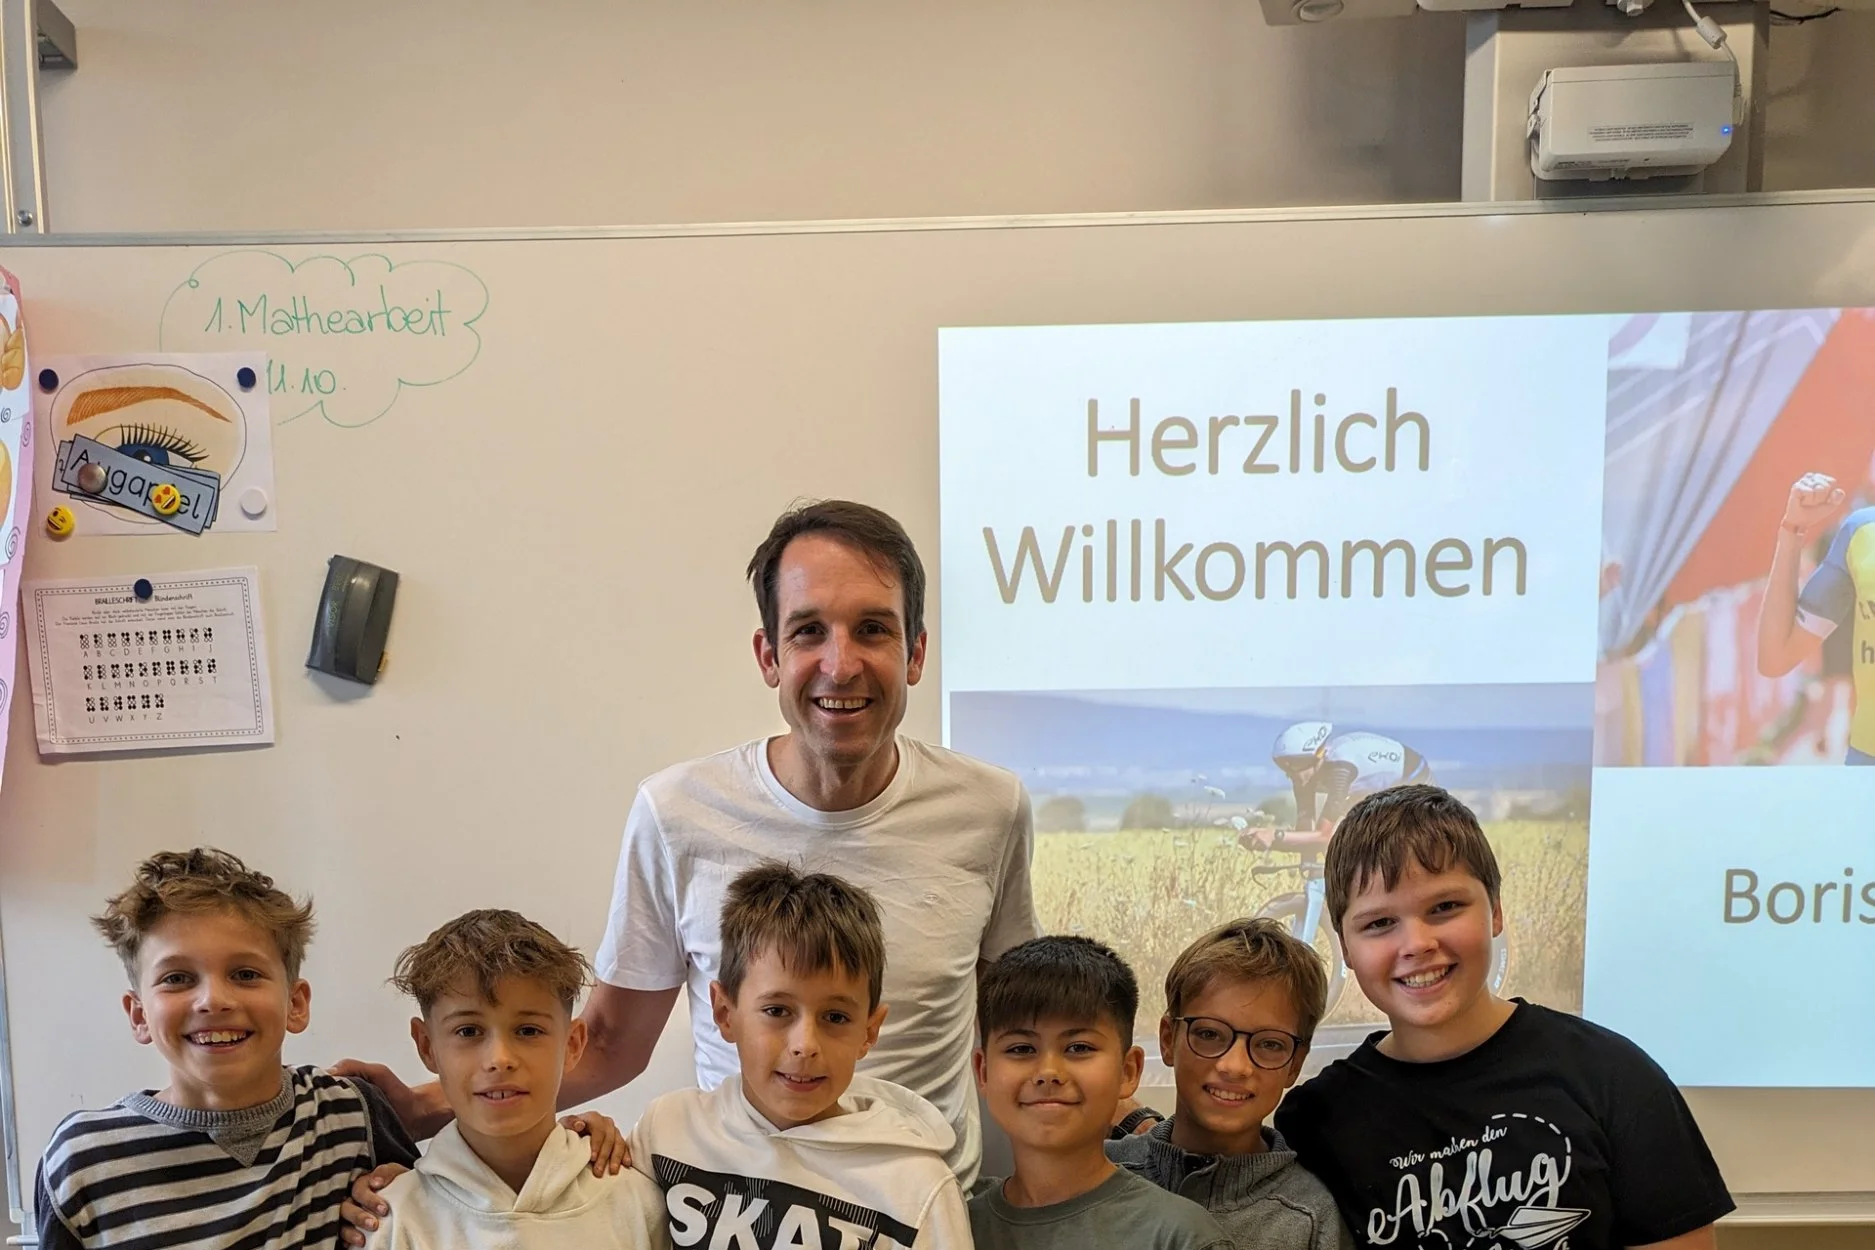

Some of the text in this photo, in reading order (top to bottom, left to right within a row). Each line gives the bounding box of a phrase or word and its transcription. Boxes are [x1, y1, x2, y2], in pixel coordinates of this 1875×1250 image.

[1086, 386, 1431, 478] Herzlich
[70, 448, 202, 520] Agapel
[982, 518, 1528, 604] Willkommen
[1723, 867, 1875, 925] Boris
[1389, 1150, 1425, 1169] Wir
[1482, 1125, 1507, 1143] den
[1367, 1148, 1560, 1245] Abflug
